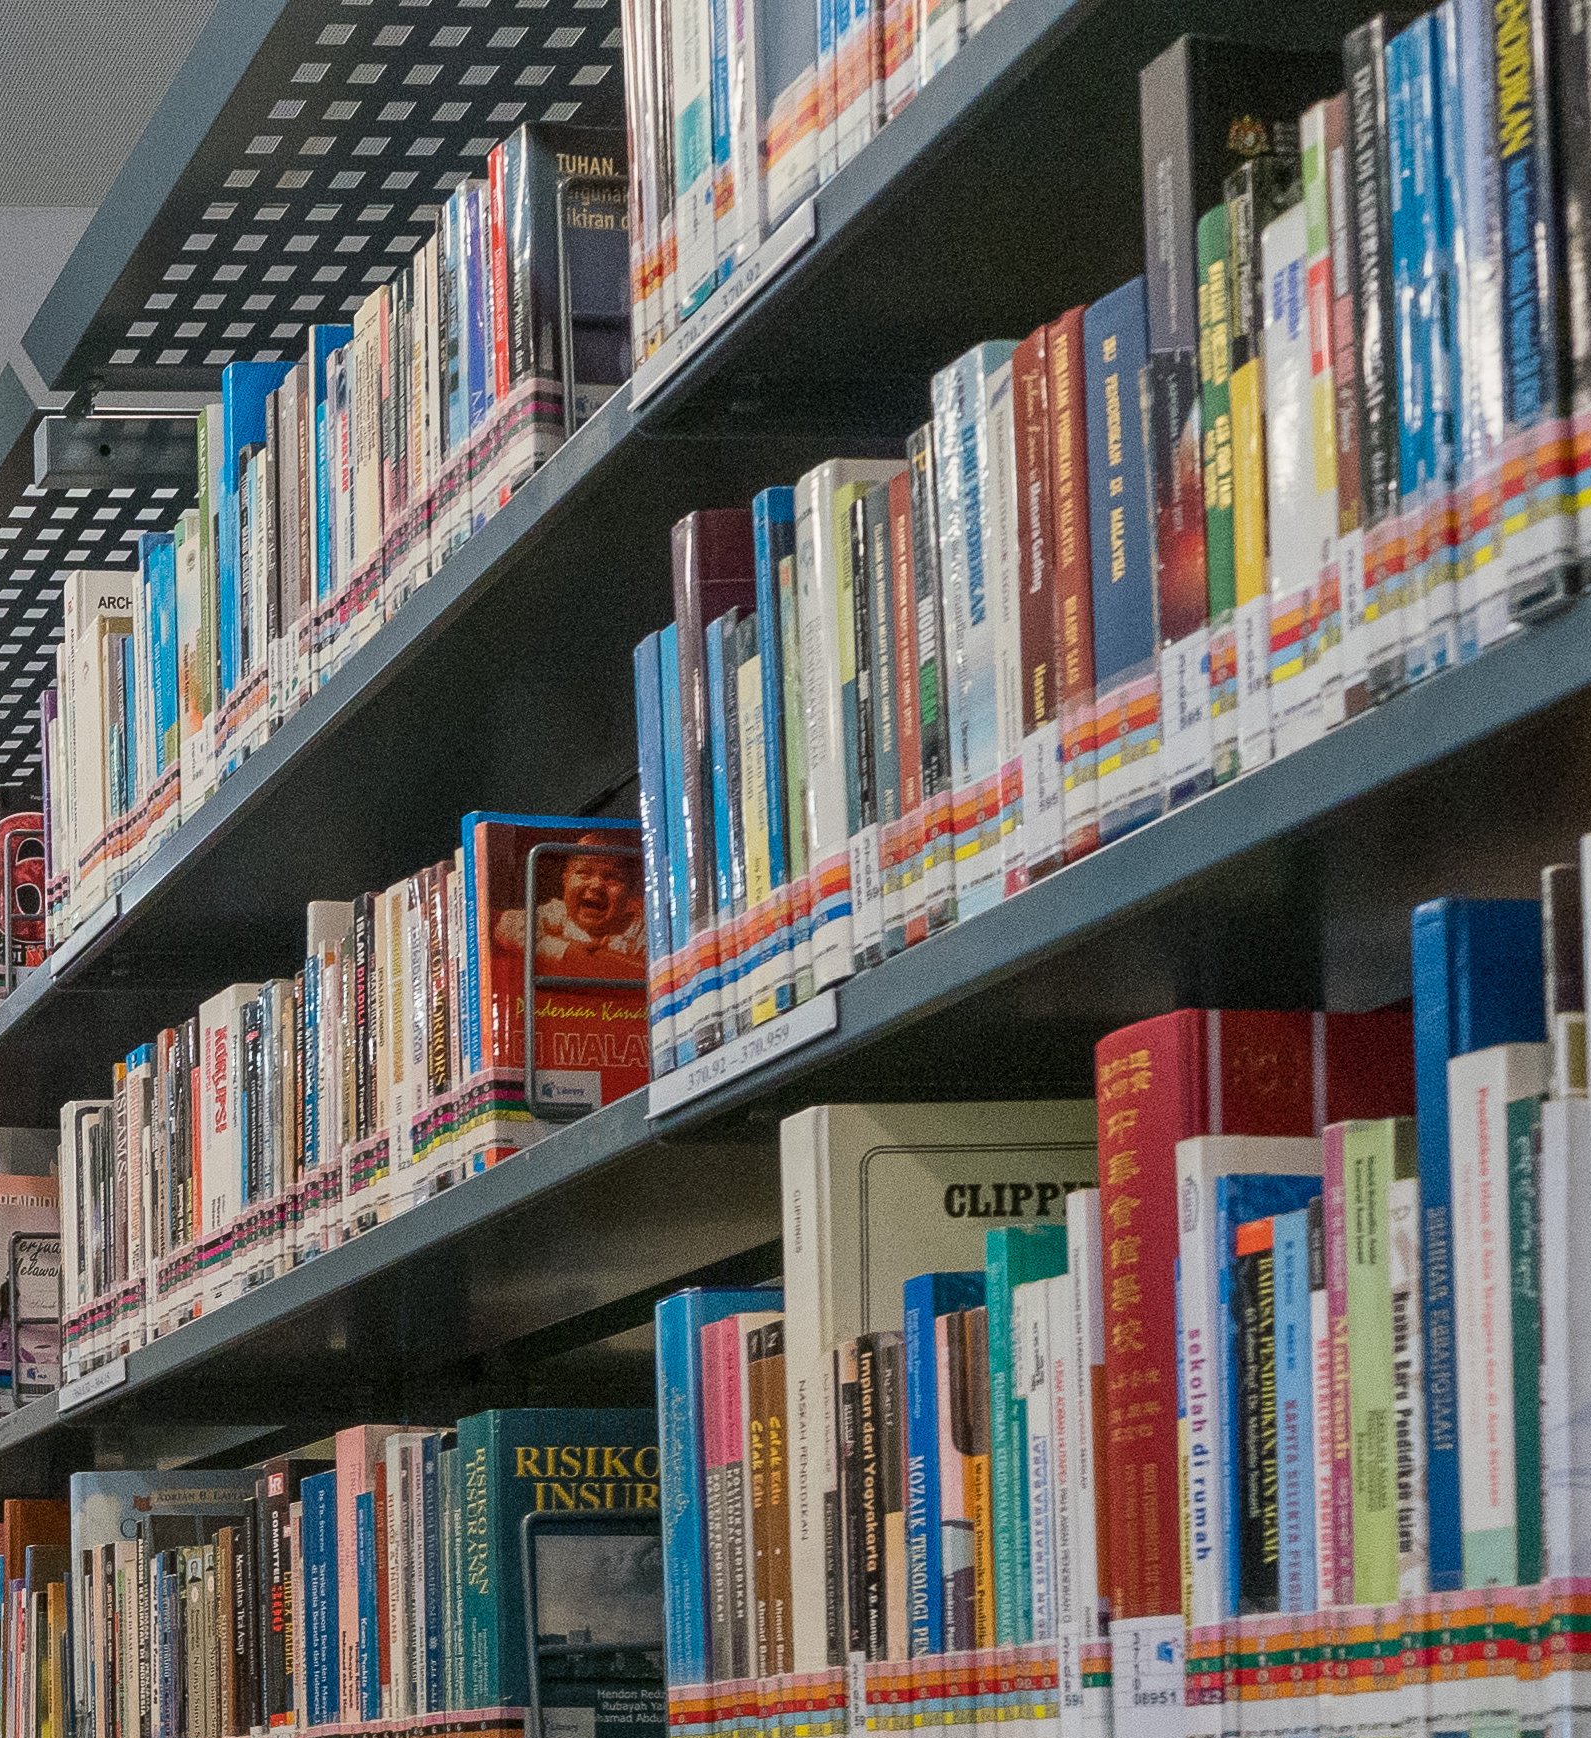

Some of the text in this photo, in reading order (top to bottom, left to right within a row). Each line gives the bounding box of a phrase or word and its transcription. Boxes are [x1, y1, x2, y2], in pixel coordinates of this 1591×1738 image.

[1188, 1329, 1208, 1432] sekolah
[512, 1446, 658, 1478] RISIKO
[1193, 1477, 1210, 1560] rumah
